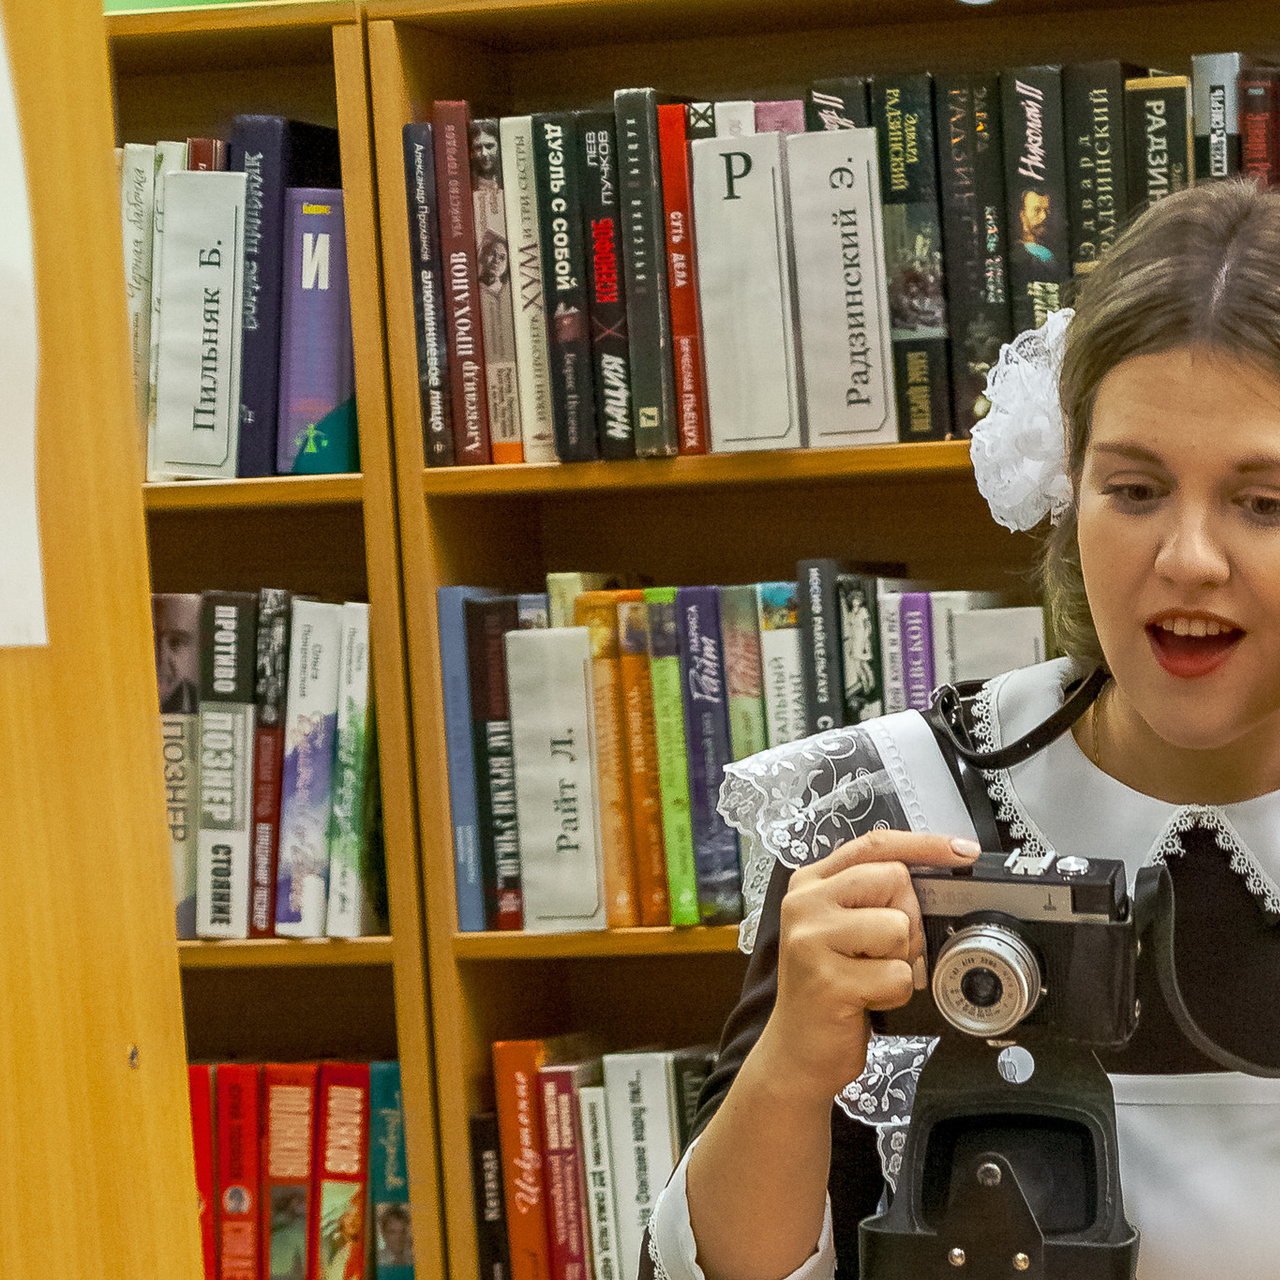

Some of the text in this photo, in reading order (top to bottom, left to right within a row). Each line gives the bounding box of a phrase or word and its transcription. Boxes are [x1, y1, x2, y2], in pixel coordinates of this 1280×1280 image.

[514, 135, 529, 192] СЕСТРЫ
[543, 124, 571, 192] ДУЭЛЬ
[586, 131, 598, 167] ЛЕВ
[598, 130, 615, 205] ПУЧКОВ
[885, 89, 908, 190] РАДЗИНСКИЙ
[902, 113, 919, 164] ЭДВАРД
[1016, 79, 1046, 181] Николай II
[413, 144, 430, 204] Александр
[517, 195, 531, 222] ТРИ
[551, 198, 568, 212] С
[720, 150, 753, 201] Р
[301, 233, 330, 290] И
[553, 216, 576, 291] СОБОЙ
[590, 218, 619, 303] КСЕНОФОБ
[669, 211, 685, 243] СУТЬ
[450, 251, 475, 357] ПРОХАНОВ
[517, 242, 544, 312] ХУМ
[670, 253, 687, 288] ДЕЛА
[830, 157, 875, 407] Радзинский Э.
[192, 239, 222, 432] Пильняк Б.
[421, 270, 440, 387] алюминиевое
[427, 390, 444, 431] лицо
[460, 361, 481, 453] Александр
[601, 353, 629, 439] НАЦИЯ
[683, 393, 700, 448] ПЬЕЦУХ
[212, 606, 237, 694] ПРОТИВО
[162, 721, 190, 842] ПОЗНЕР
[200, 712, 234, 822] ПОЗНЕР
[550, 728, 580, 853] Райт Л.
[209, 844, 233, 926] СТОЯНИЕ
